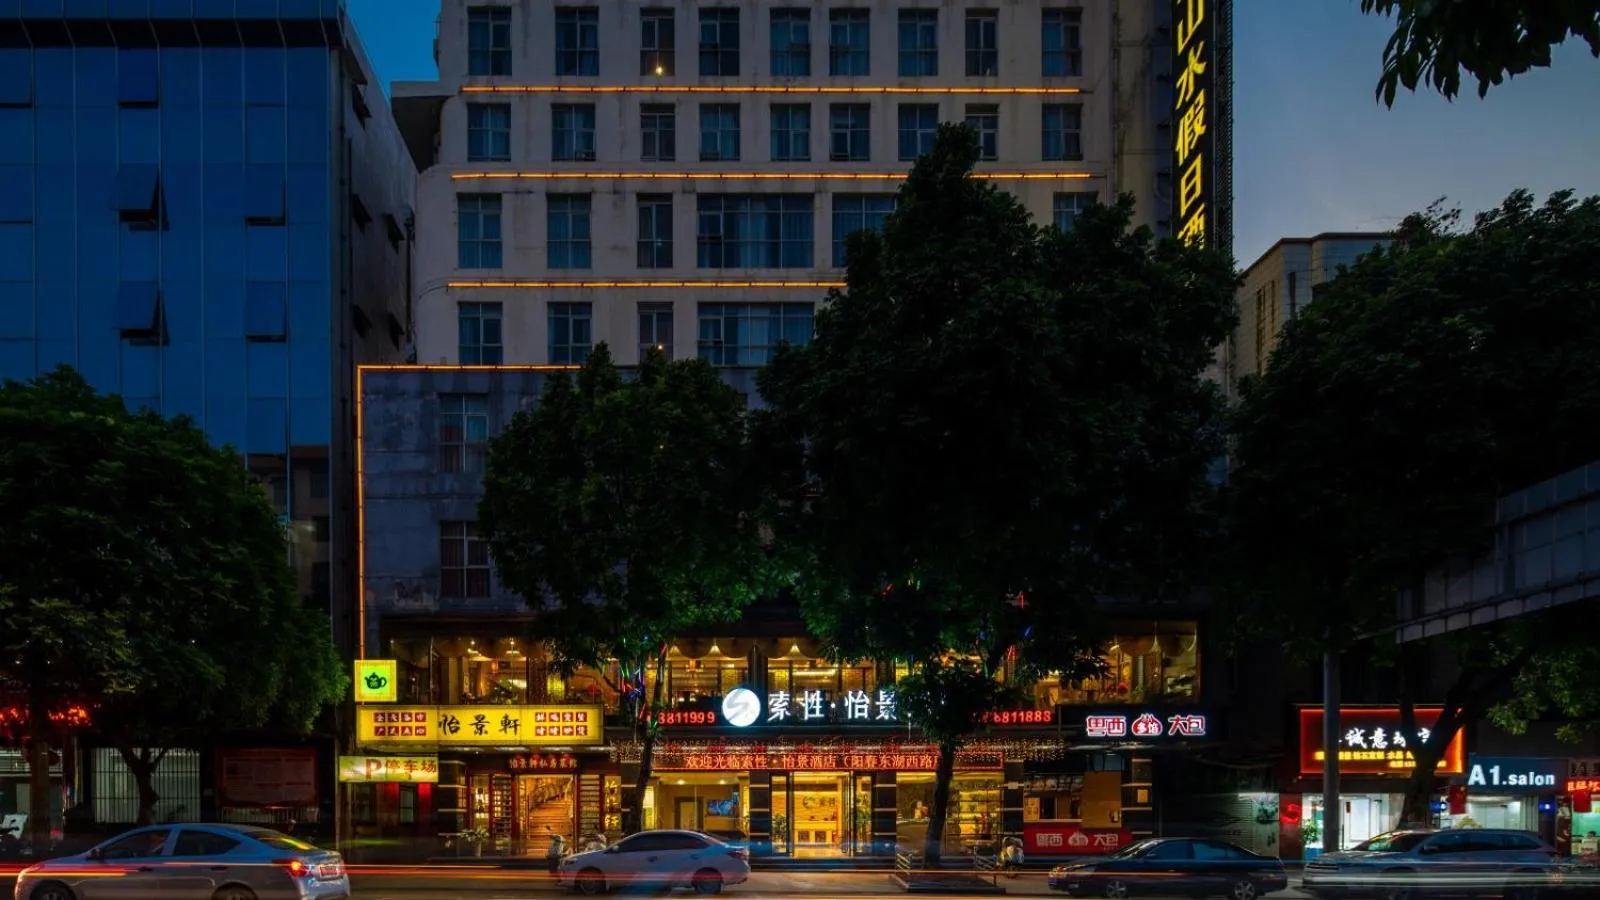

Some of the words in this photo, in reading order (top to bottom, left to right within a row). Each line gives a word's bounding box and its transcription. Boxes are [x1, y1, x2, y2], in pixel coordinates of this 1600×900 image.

[1167, 714, 1206, 736] 大包
[366, 759, 382, 780] P
[385, 759, 437, 775] 停车场
